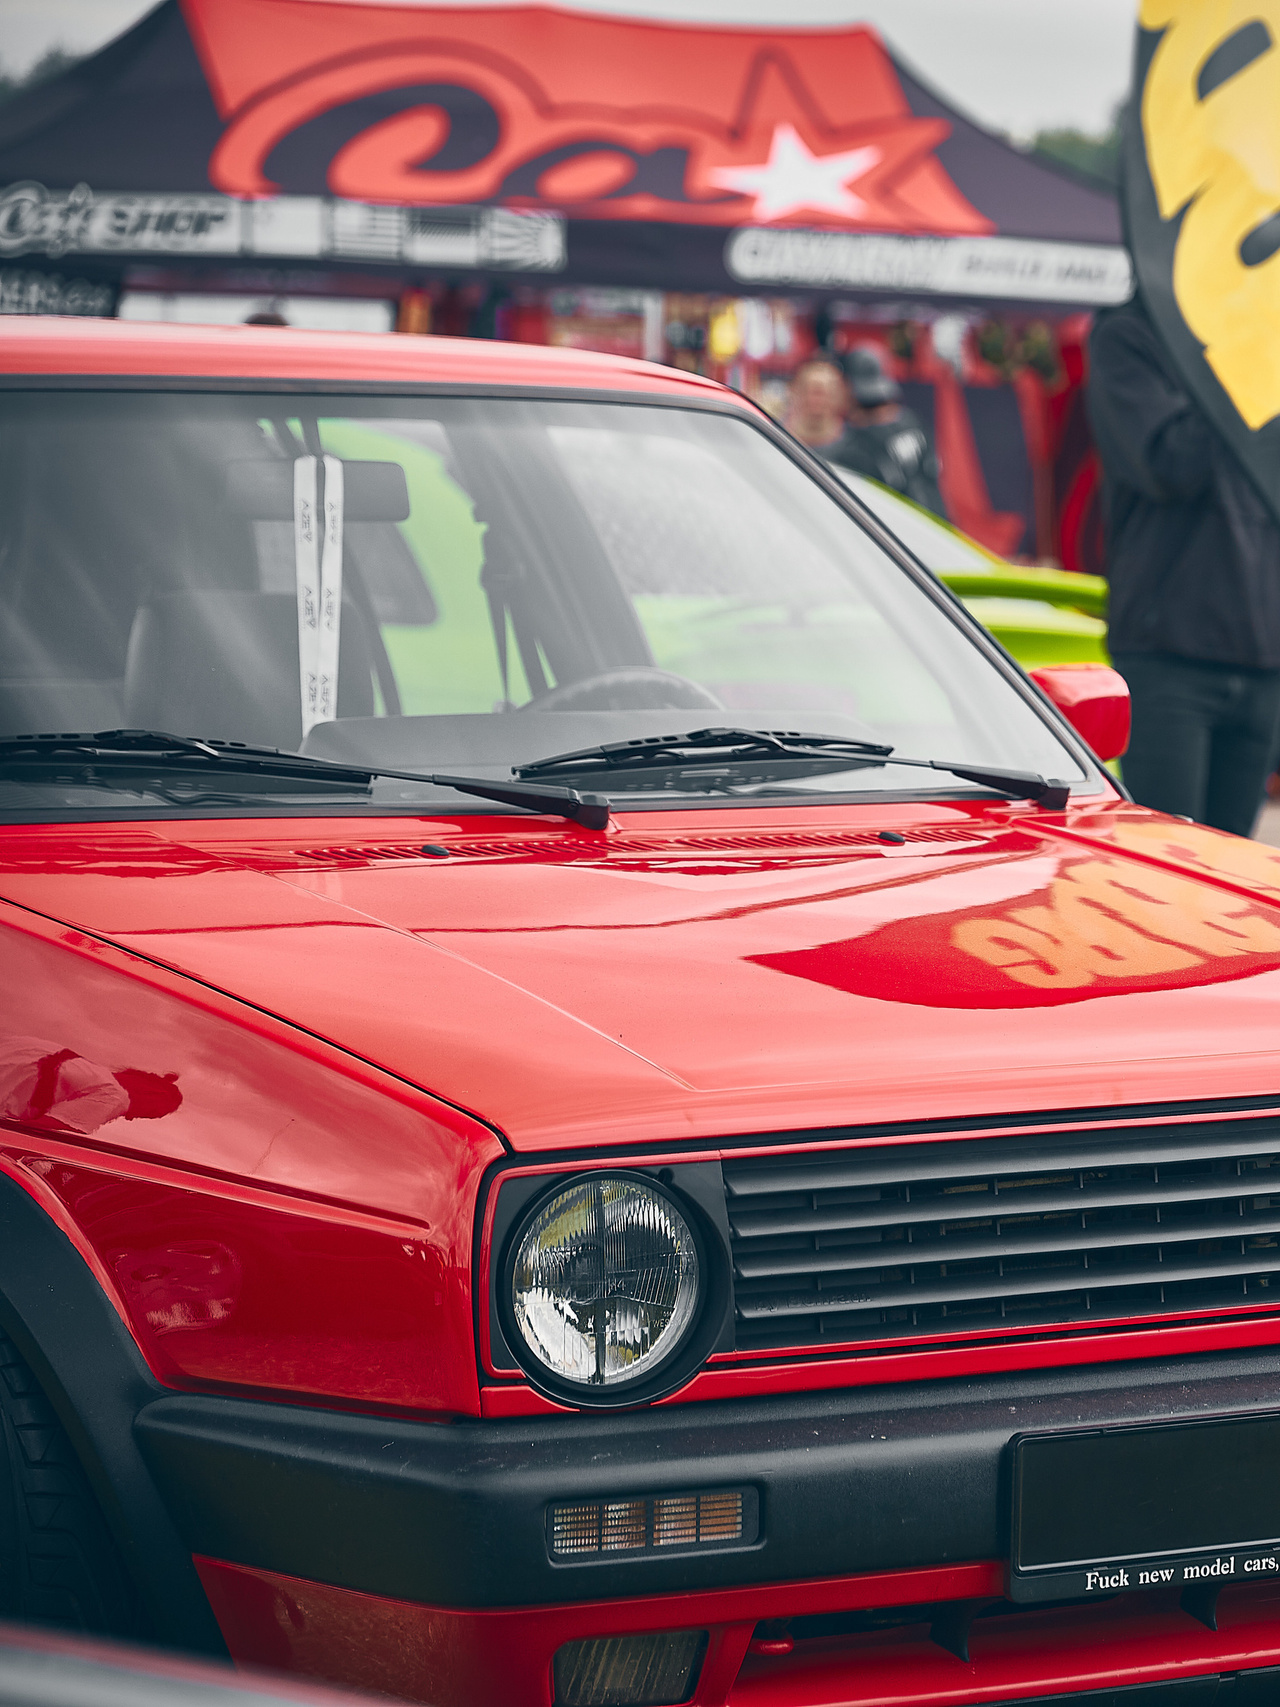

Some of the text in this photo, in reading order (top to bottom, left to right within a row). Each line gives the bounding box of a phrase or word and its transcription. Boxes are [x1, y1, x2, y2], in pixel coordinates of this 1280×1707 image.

[1085, 1568, 1130, 1591] Fuck
[1138, 1569, 1175, 1585] new
[1183, 1556, 1235, 1579] model
[1243, 1557, 1280, 1572] cars,
